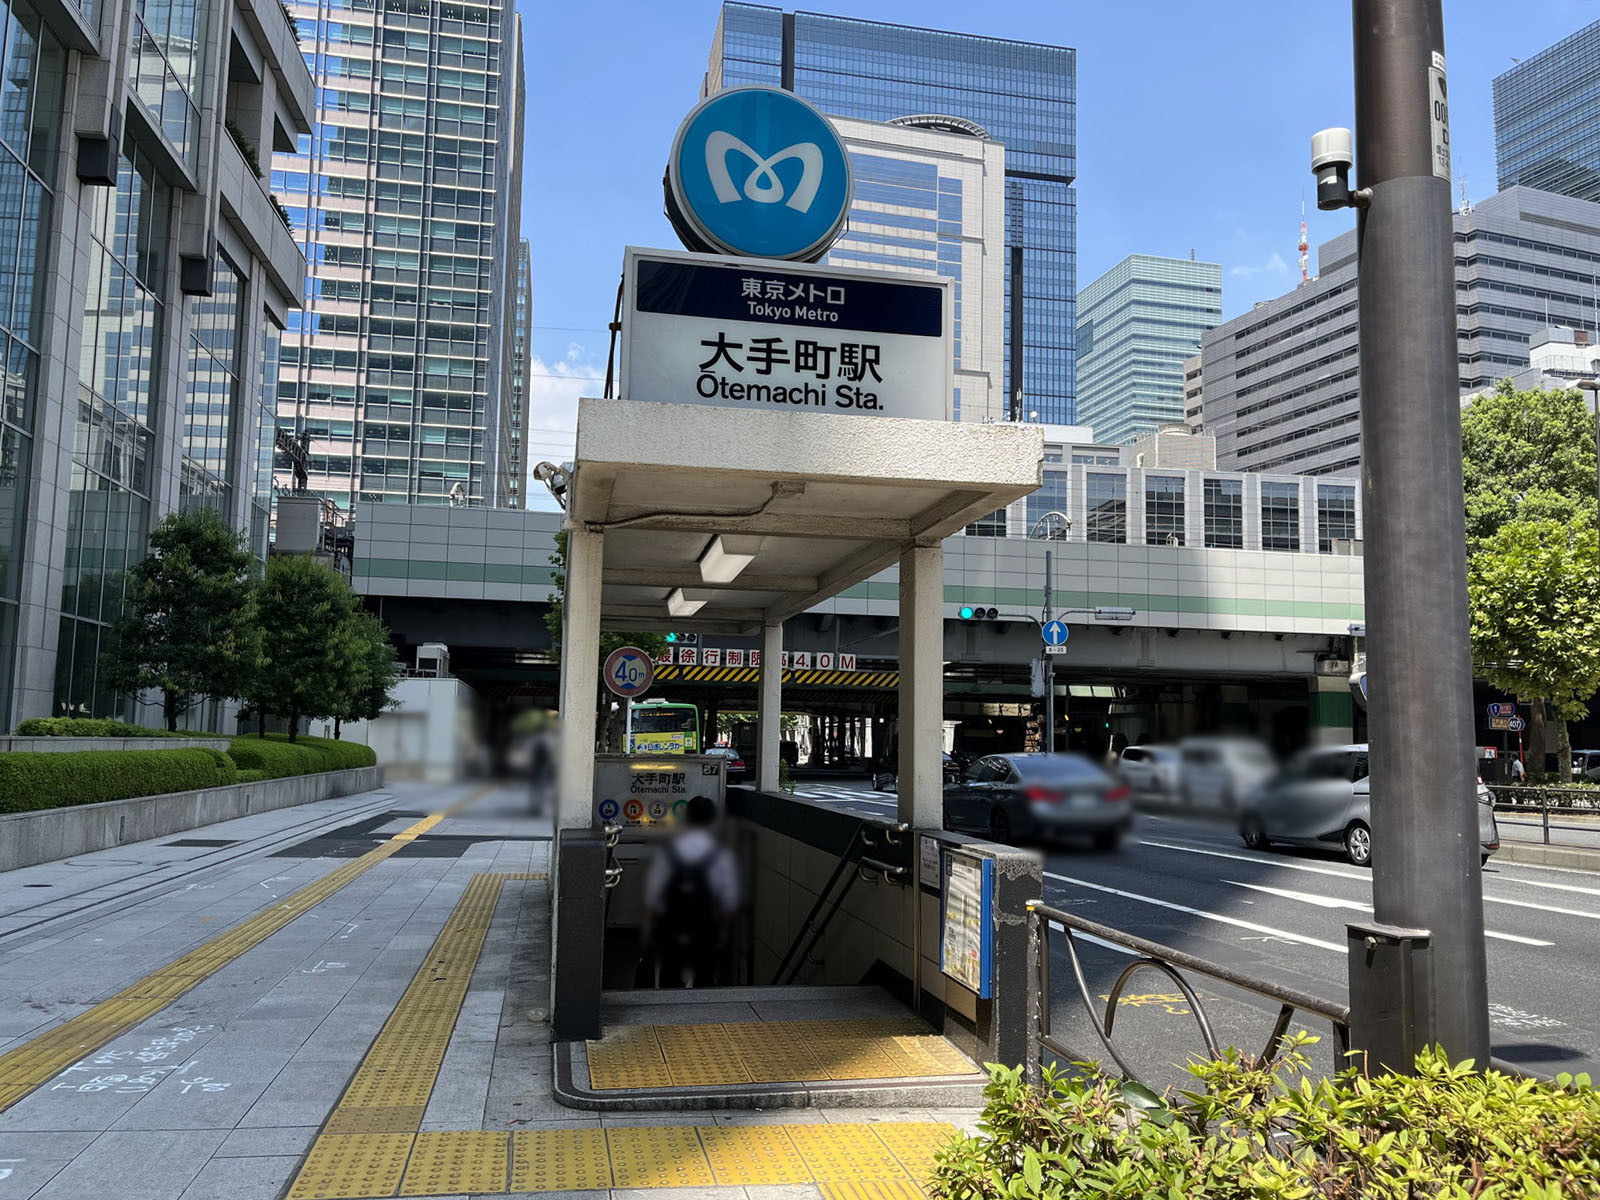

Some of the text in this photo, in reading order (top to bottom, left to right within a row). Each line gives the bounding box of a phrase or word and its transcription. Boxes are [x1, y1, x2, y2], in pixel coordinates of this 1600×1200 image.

[740, 277, 846, 305] 東京メトロ
[747, 301, 839, 322] Tokyo Metro
[698, 332, 884, 384] 大手町駅
[835, 385, 885, 411] Sta.
[631, 773, 686, 785] 大手町駅
